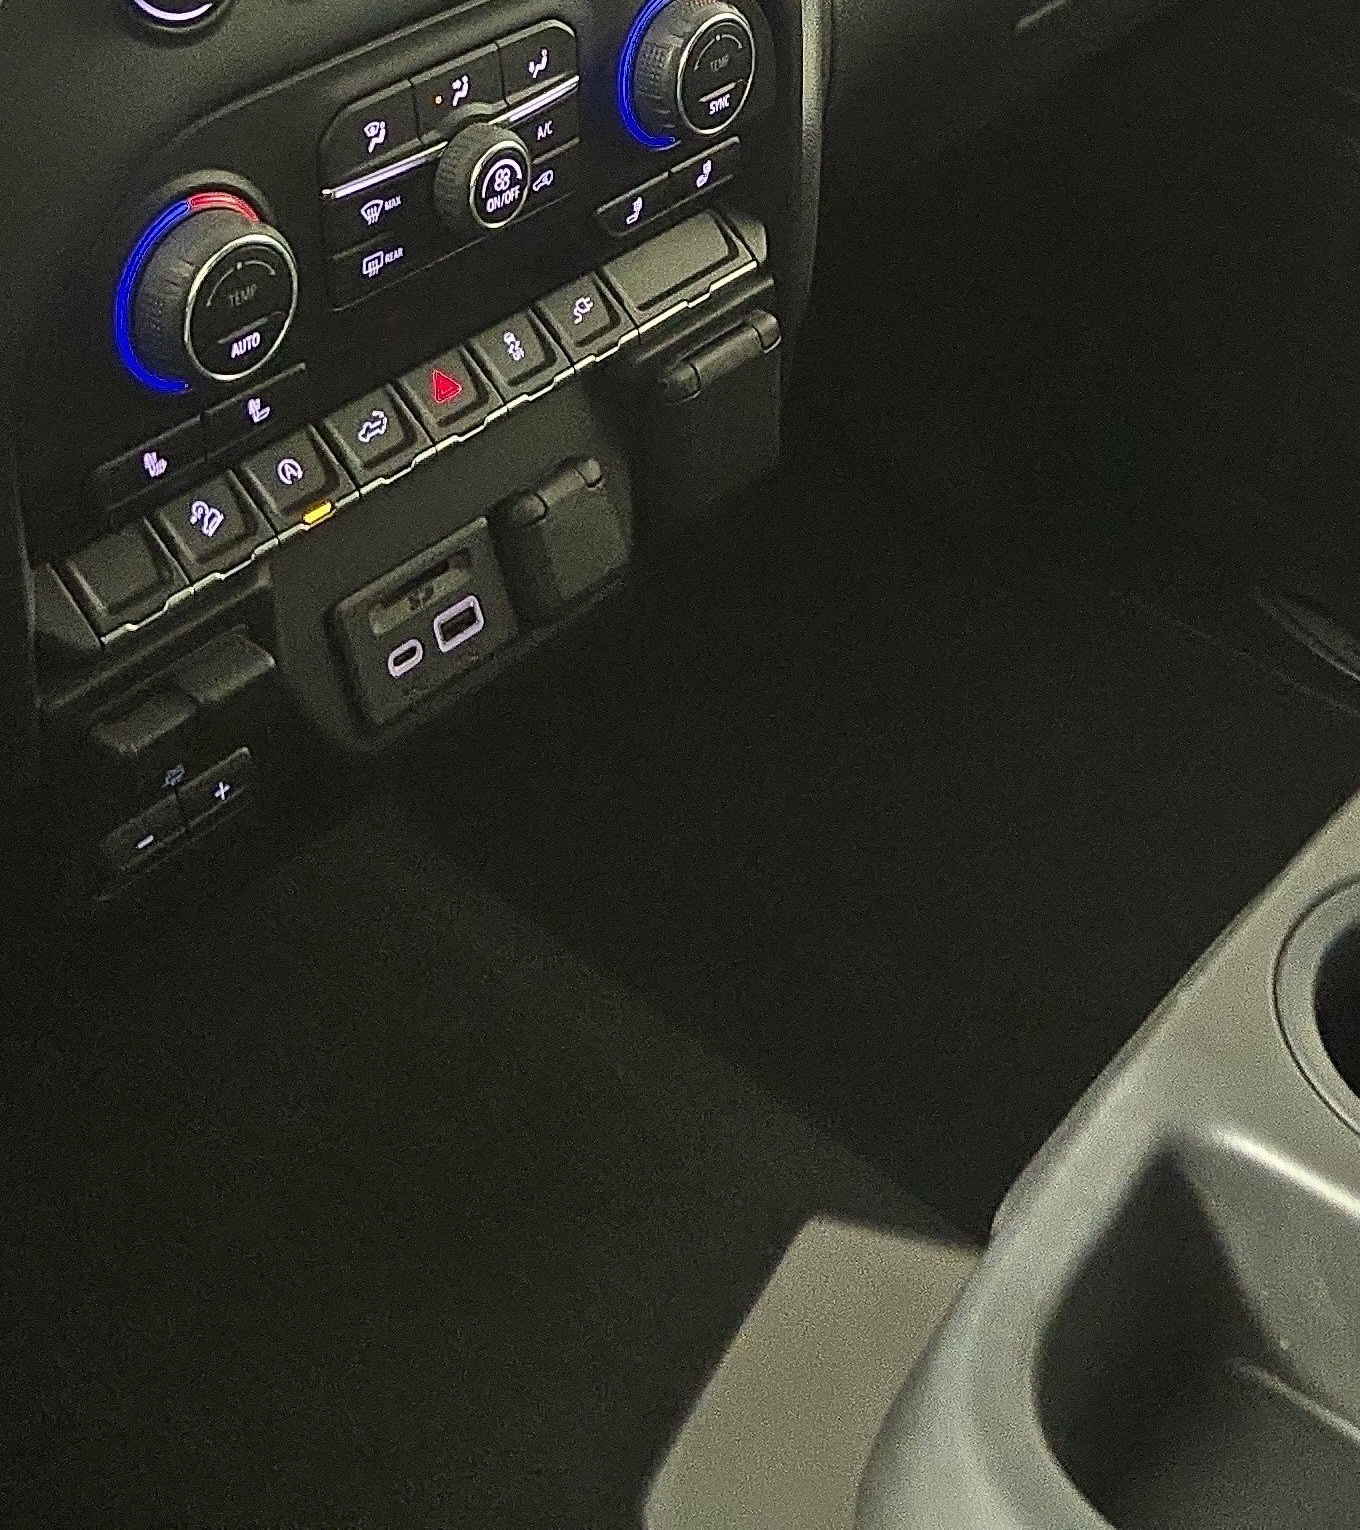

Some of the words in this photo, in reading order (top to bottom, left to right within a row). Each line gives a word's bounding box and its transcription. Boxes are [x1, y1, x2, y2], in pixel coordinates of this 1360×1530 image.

[709, 93, 731, 115] SYNC
[537, 121, 553, 140] A/C
[384, 195, 402, 211] MAX
[486, 185, 520, 213] ON/OFF
[384, 247, 404, 264] REAR
[228, 283, 258, 307] TEMP
[231, 331, 261, 359] AUTO
